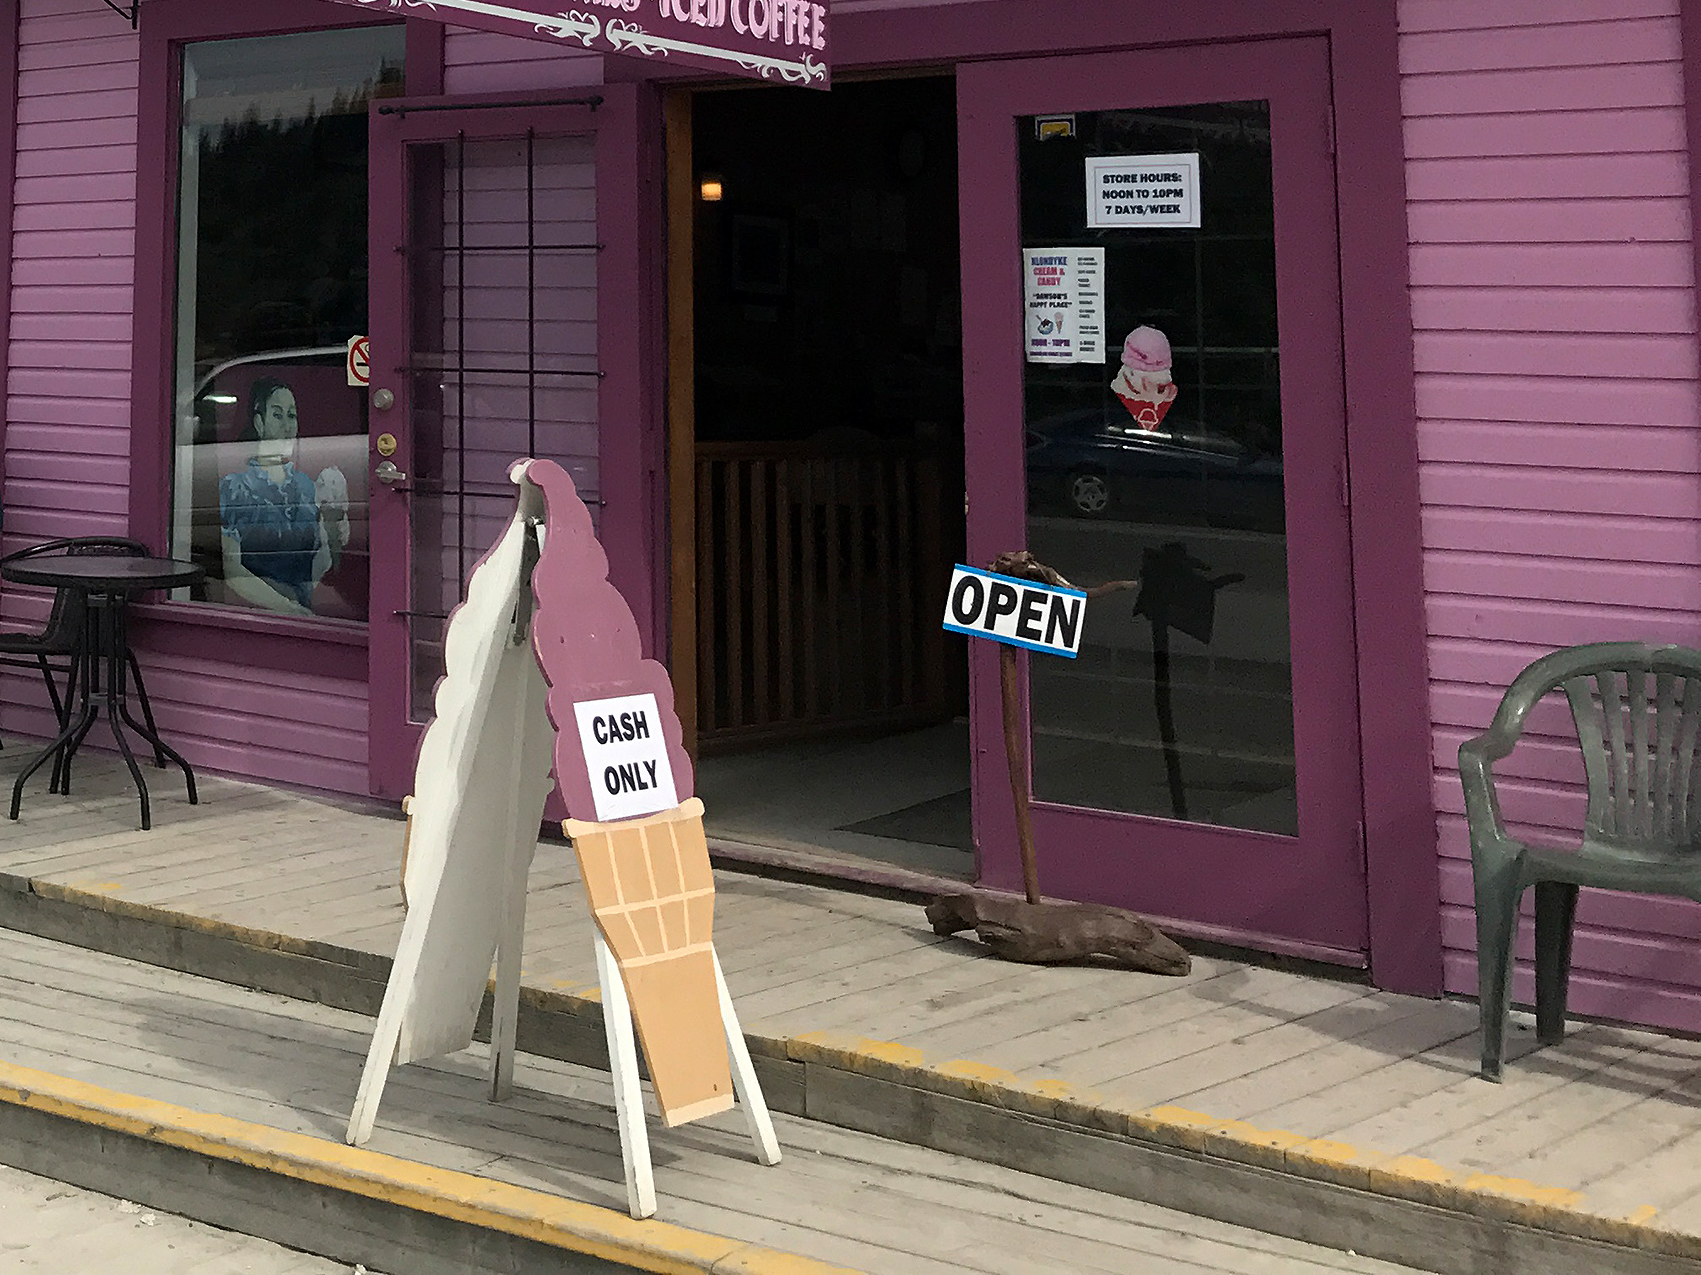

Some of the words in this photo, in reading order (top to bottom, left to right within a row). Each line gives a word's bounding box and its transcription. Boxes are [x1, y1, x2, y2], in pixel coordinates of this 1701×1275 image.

[1103, 174, 1137, 183] STORE
[1140, 173, 1182, 183] HOURS:
[1102, 190, 1133, 199] NOON
[1136, 189, 1149, 198] TO
[1152, 188, 1184, 198] 10PM
[1105, 206, 1112, 214] 7
[1115, 204, 1181, 216] DAYS/WEEK
[952, 575, 1081, 648] OPEN
[593, 711, 650, 744] CASH
[604, 759, 657, 795] ONLY
